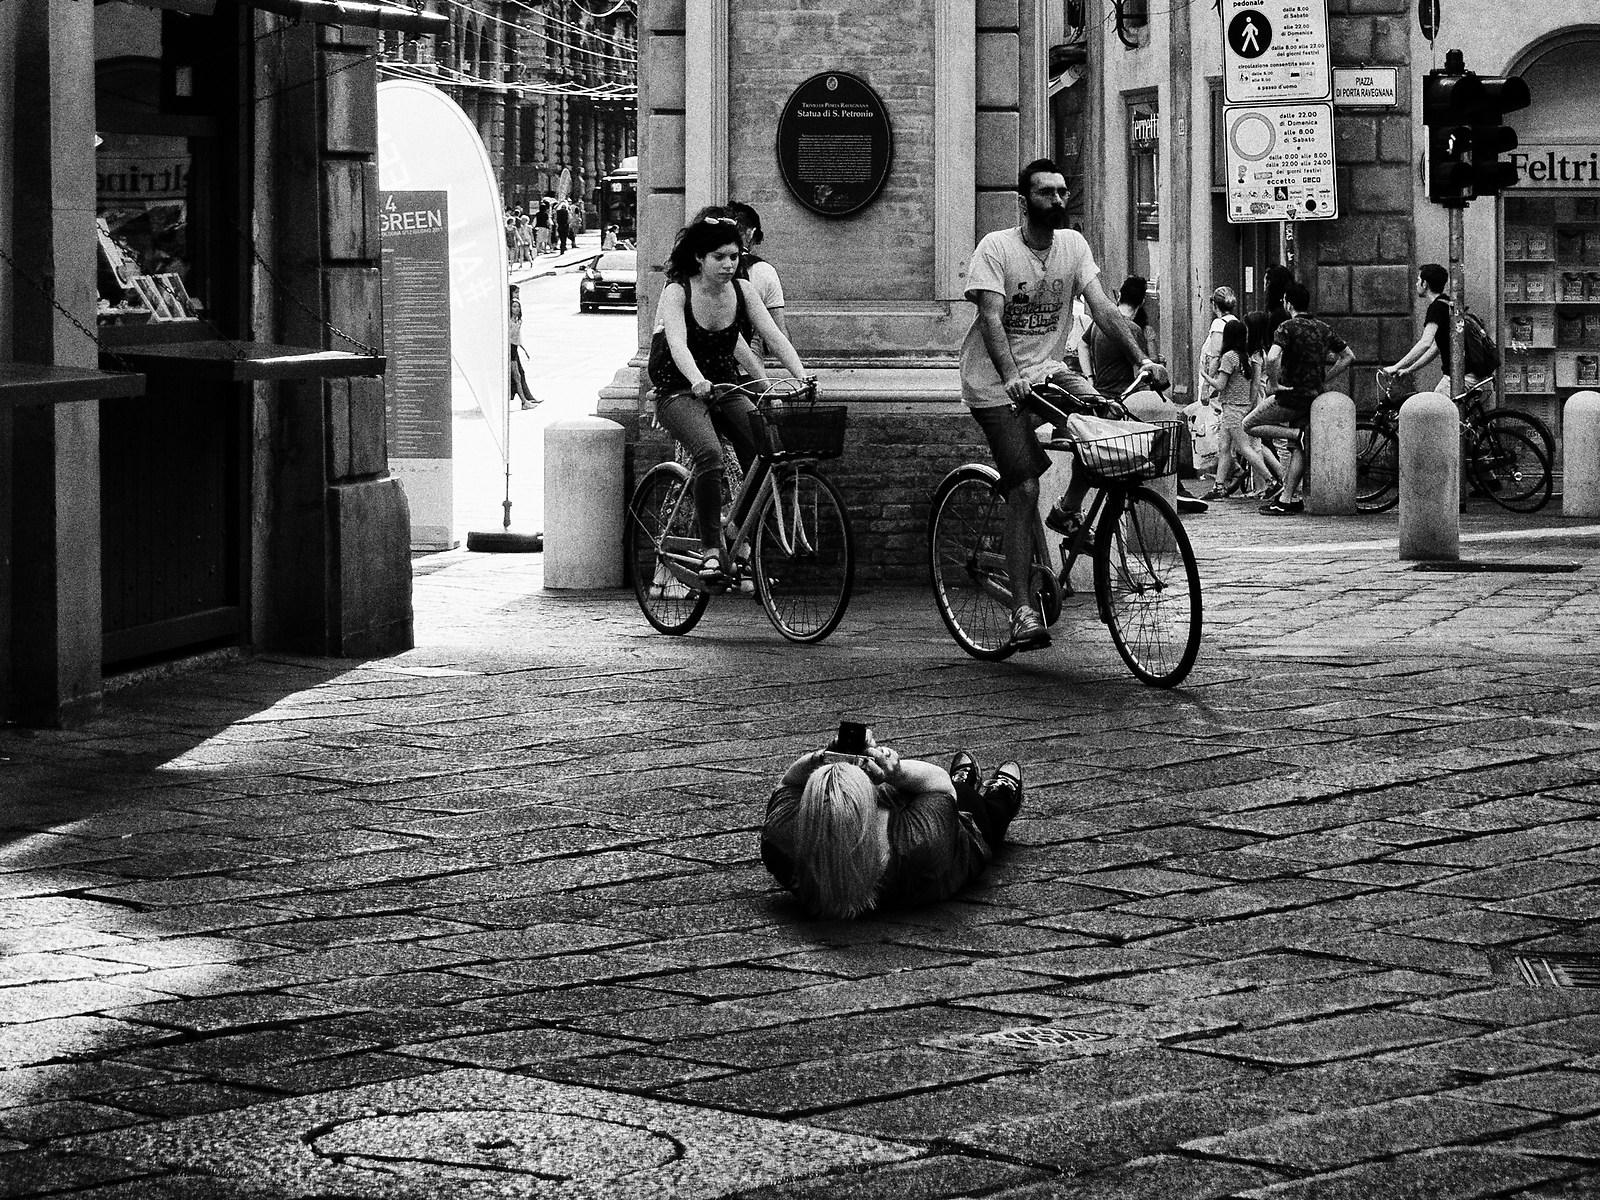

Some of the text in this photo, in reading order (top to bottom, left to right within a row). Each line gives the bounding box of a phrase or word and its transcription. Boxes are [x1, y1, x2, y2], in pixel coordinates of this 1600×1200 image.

[1233, 0, 1264, 7] pedonale
[1355, 77, 1373, 86] PIAZZA
[1336, 88, 1394, 97] DI PORTA RAVEGNANA
[797, 109, 874, 118] Statua di S. Petronio
[1508, 151, 1600, 181] Feltri
[1266, 177, 1296, 185] eccetto
[380, 209, 442, 232] GREEN
